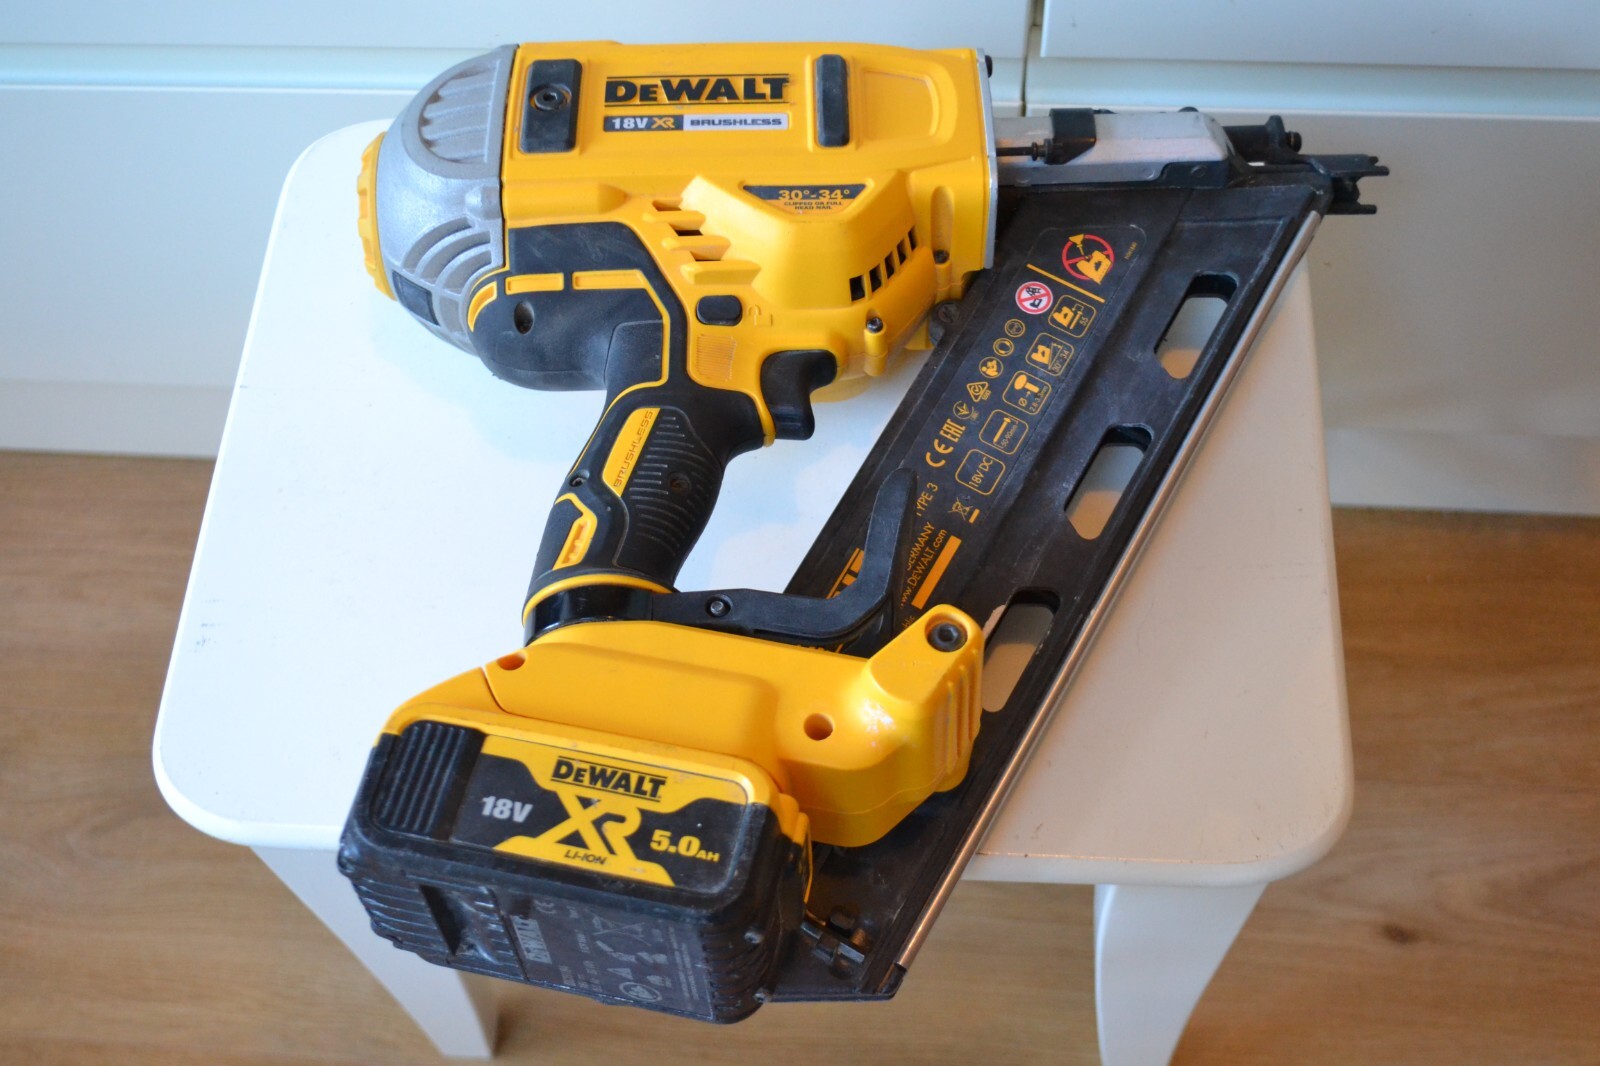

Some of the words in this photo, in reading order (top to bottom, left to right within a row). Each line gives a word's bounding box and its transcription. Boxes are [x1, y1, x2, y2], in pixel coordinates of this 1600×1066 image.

[612, 116, 648, 130] 18V
[651, 116, 675, 129] XR
[690, 117, 782, 126] BRUSHLESS
[613, 410, 654, 488] BRUSHLESS
[968, 472, 985, 488] 18V
[979, 456, 994, 472] DC
[926, 482, 939, 493] 3
[480, 796, 533, 823] 18V
